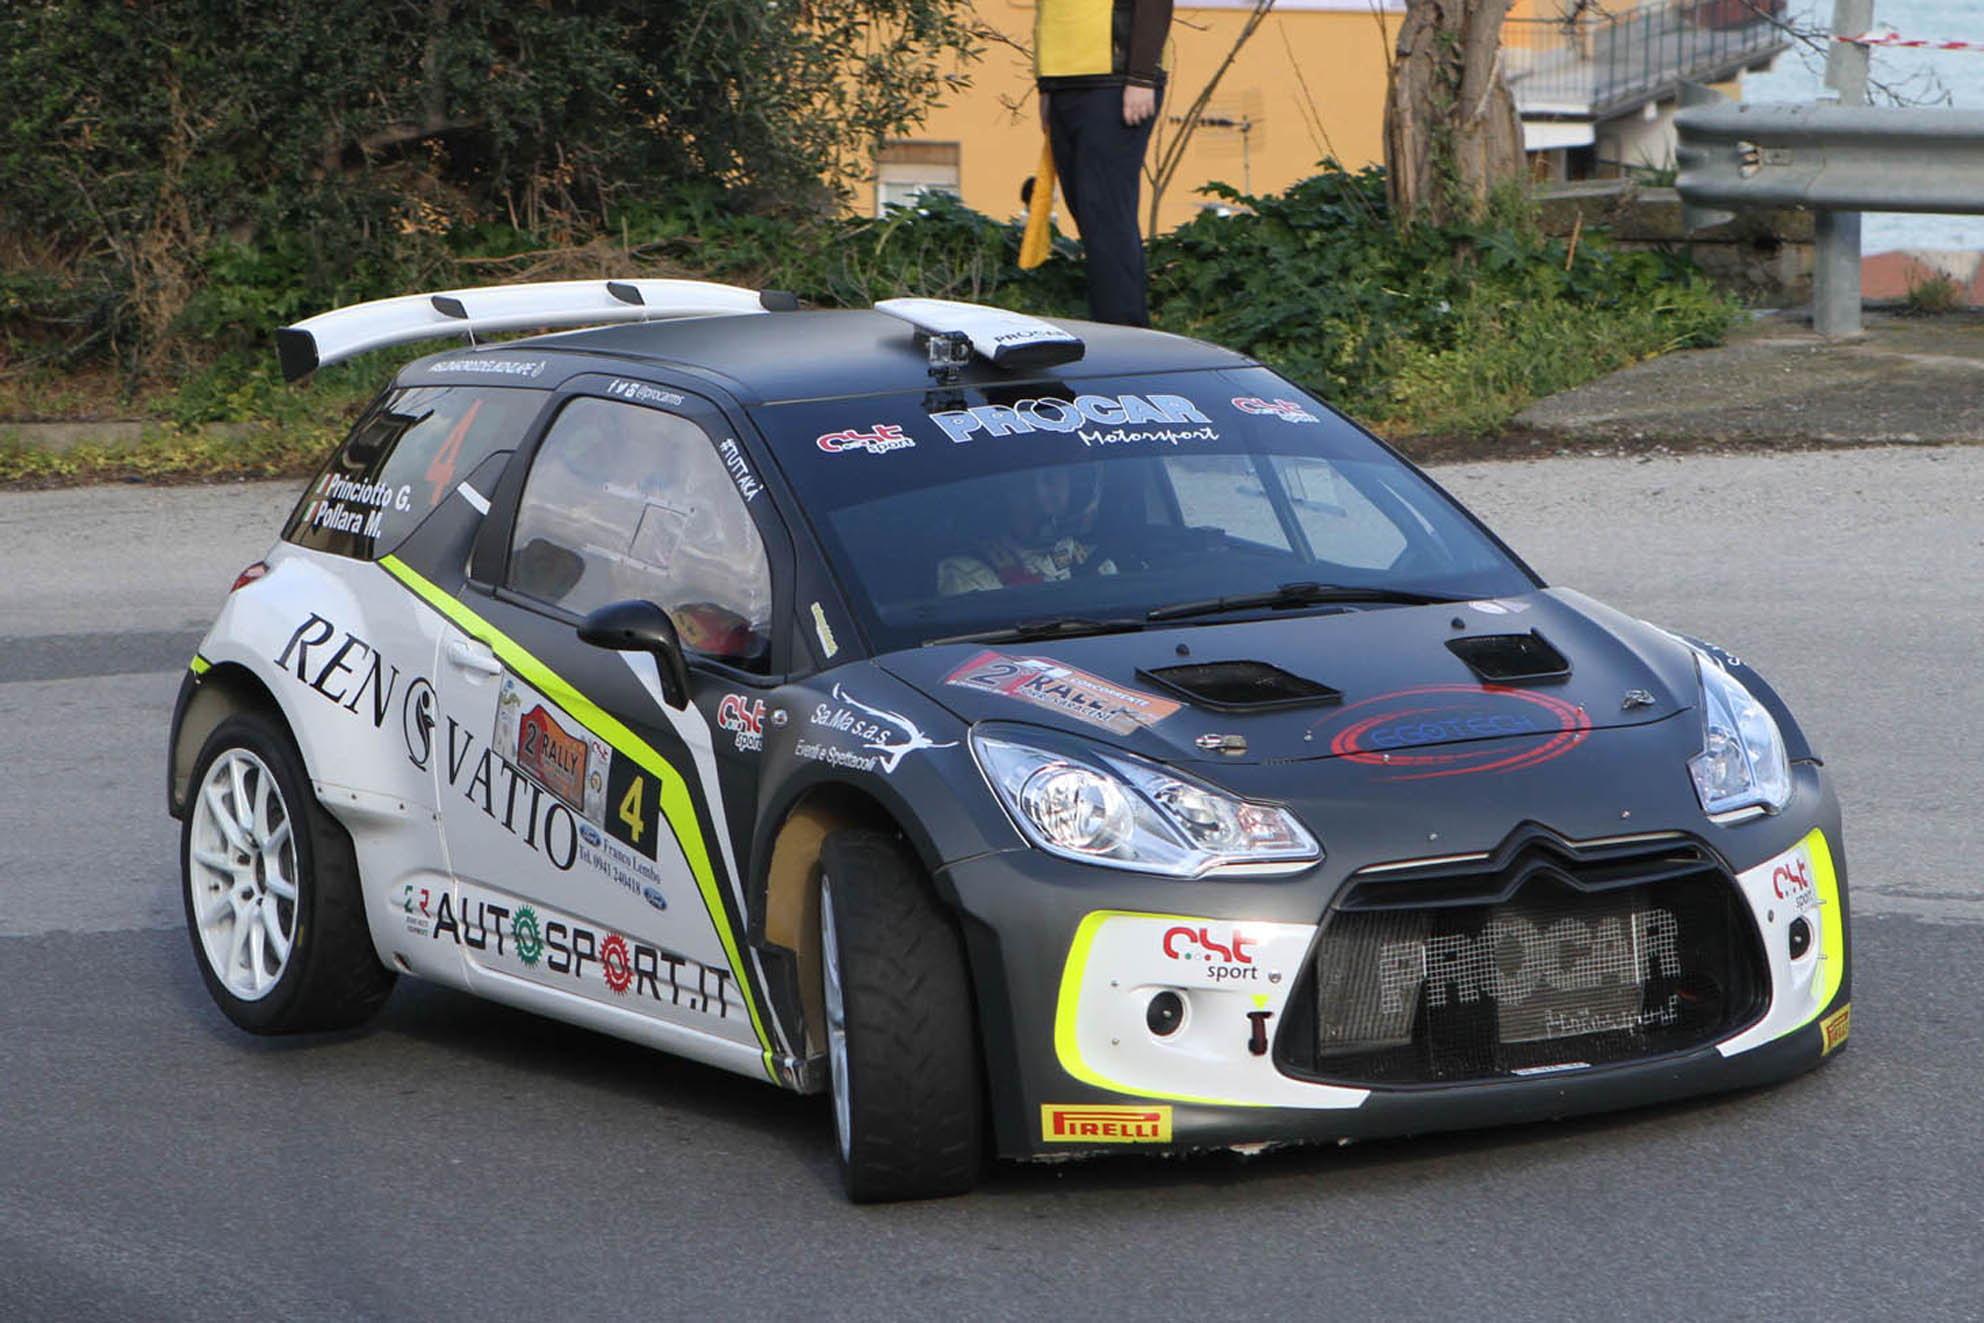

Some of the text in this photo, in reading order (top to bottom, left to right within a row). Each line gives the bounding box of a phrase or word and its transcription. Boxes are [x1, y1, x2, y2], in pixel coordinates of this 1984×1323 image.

[928, 394, 1213, 443] PROCAR
[1077, 427, 1221, 447] Motorsport
[425, 399, 484, 506] 4
[326, 473, 412, 513] Princiotto G.
[315, 500, 382, 539] Pollara M.
[970, 665, 1018, 685] 2
[273, 610, 578, 872] RENOVATIO
[524, 721, 580, 777] 2 RALLY
[827, 746, 877, 772] Spettacoli
[618, 775, 645, 843] 4
[1207, 964, 1259, 982] sport
[1380, 907, 1683, 1014] PROCAR
[1053, 1111, 1161, 1138] PIRELLI
